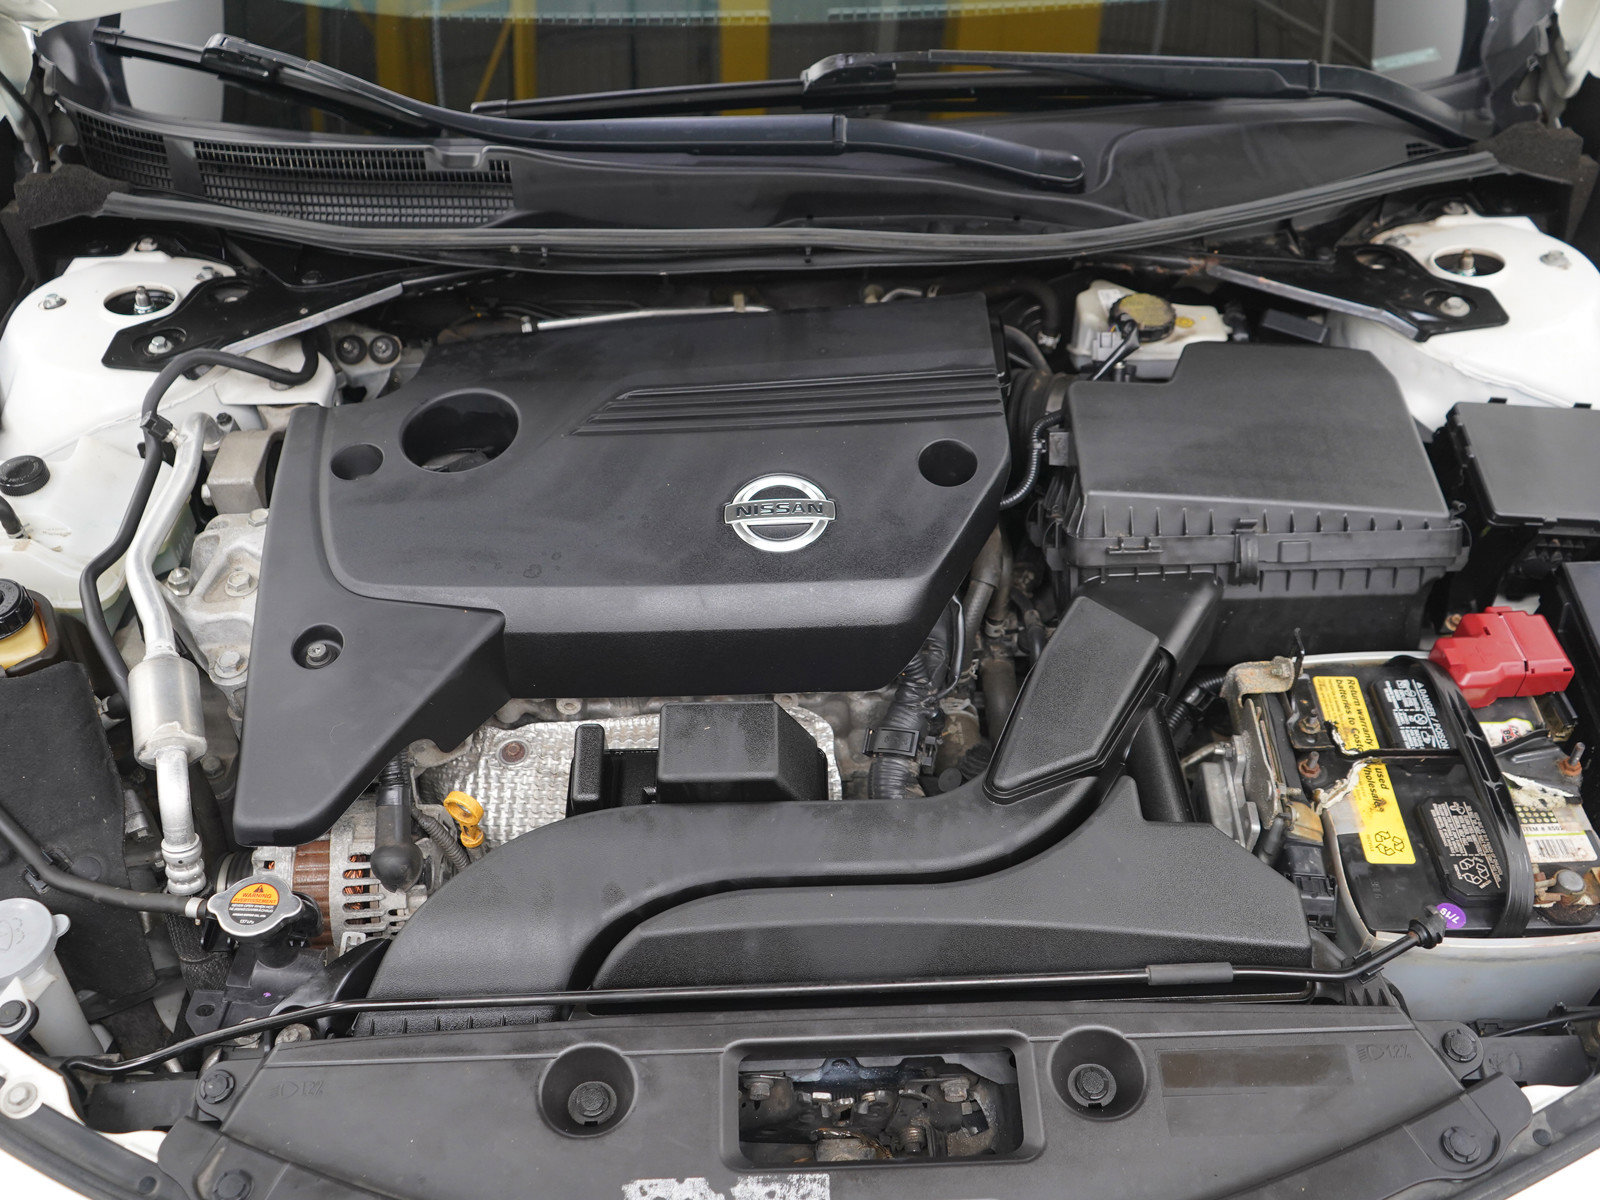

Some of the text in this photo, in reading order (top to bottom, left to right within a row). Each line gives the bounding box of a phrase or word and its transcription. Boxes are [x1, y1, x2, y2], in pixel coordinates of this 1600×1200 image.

[736, 501, 824, 518] NISSAN
[1335, 678, 1352, 715] batteries
[1348, 716, 1355, 726] to
[1347, 678, 1375, 747] Return warranty
[1419, 688, 1437, 717] DANGER
[1433, 722, 1451, 750] POISON
[1374, 767, 1390, 791] used
[1440, 907, 1460, 924] 7/19
